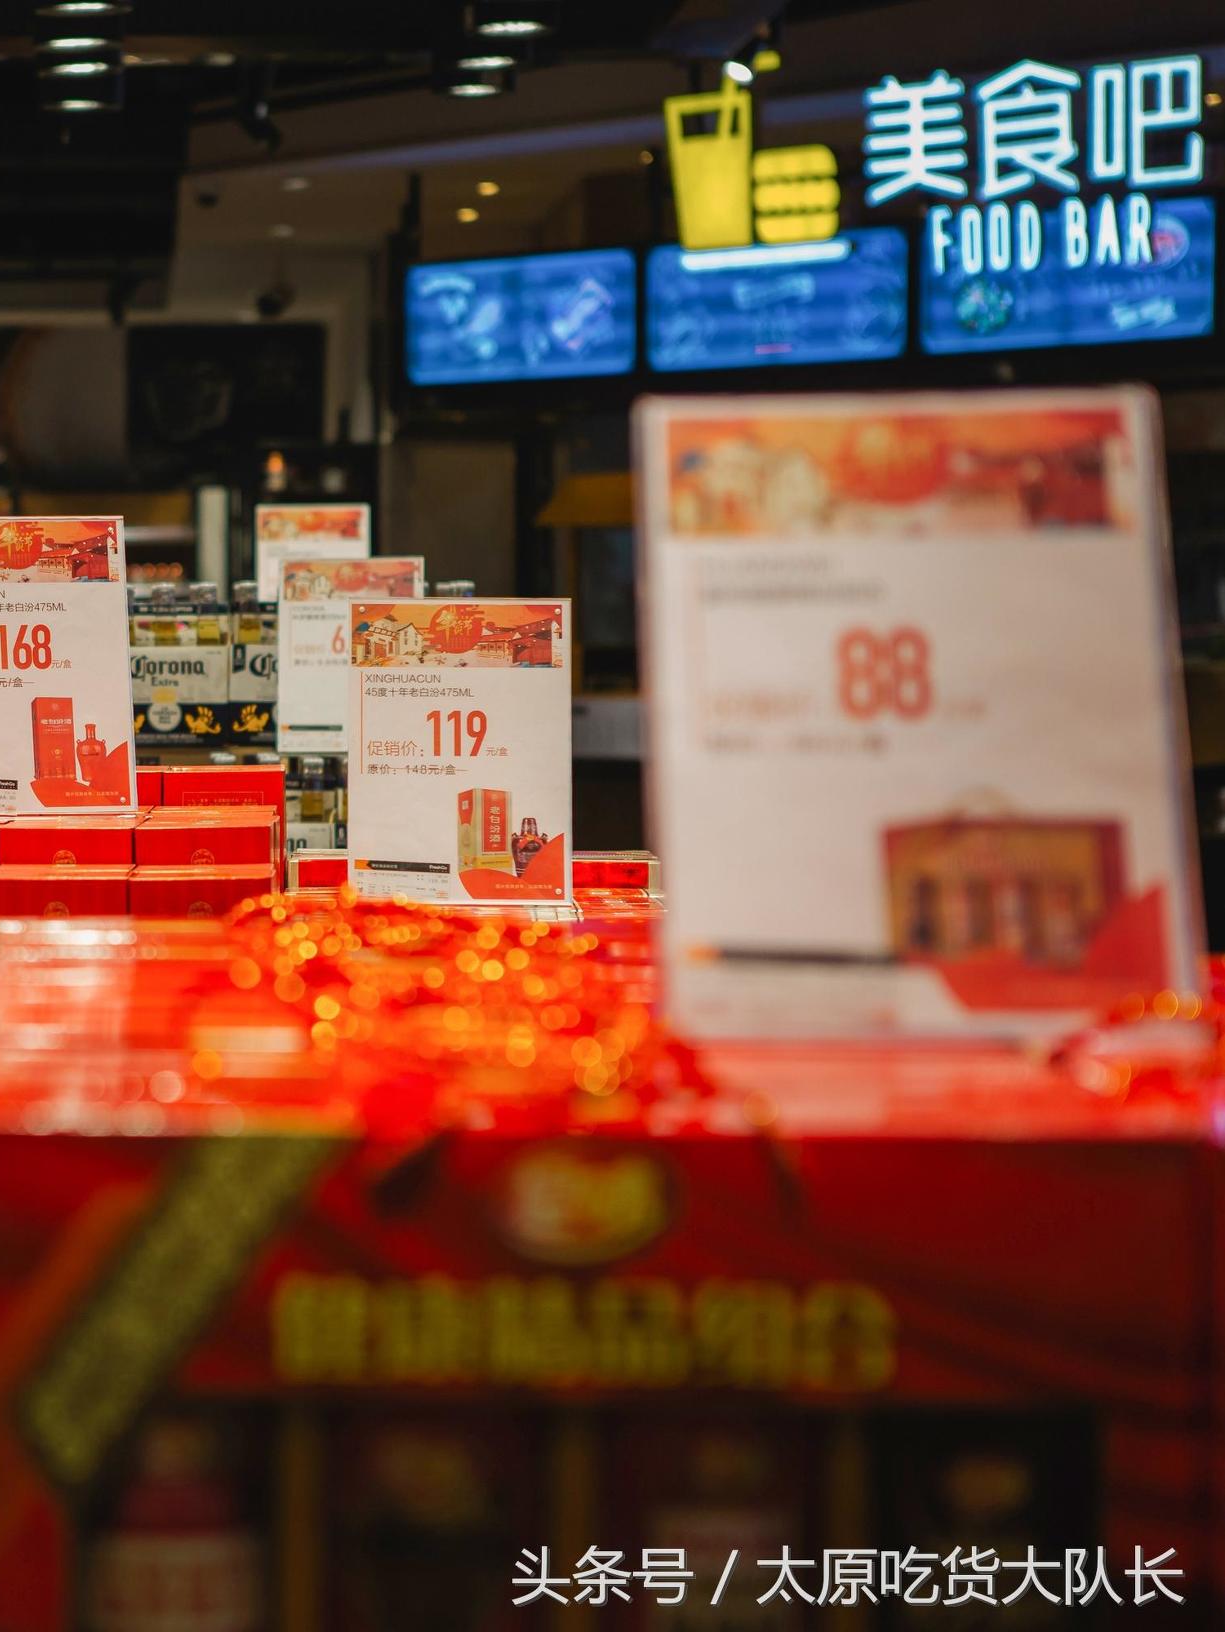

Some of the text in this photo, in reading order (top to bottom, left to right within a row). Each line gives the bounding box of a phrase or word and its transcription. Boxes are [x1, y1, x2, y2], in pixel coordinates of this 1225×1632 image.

[863, 55, 1204, 207] 美食吧
[930, 193, 1153, 276] FOOD BAR
[131, 655, 206, 681] Corona
[365, 674, 441, 683] XINGHUACUN
[837, 625, 934, 720] 88
[364, 687, 474, 697] 45度十年老白汾475ML
[426, 710, 487, 757] 119
